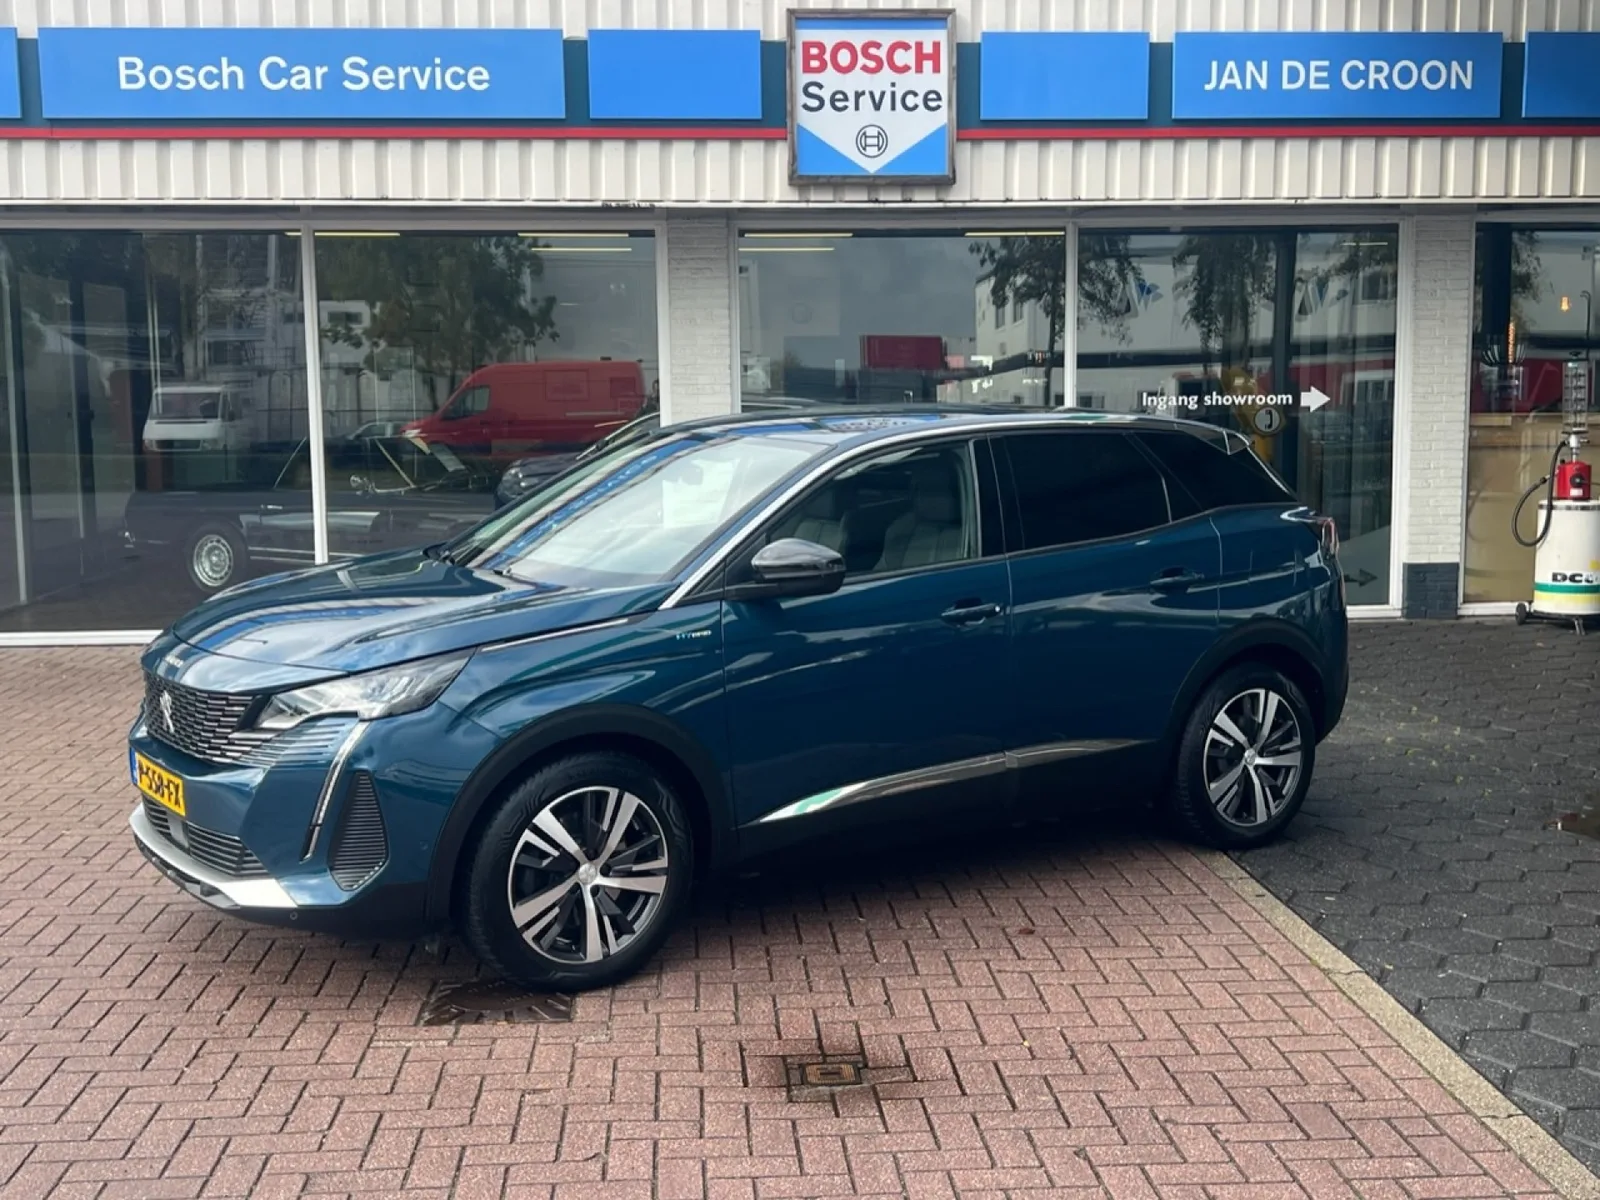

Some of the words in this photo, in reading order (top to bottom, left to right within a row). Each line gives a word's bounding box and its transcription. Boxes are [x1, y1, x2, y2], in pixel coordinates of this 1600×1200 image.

[118, 56, 245, 91] Bosch
[259, 55, 329, 91] Car
[342, 56, 490, 91] Service
[801, 40, 942, 75] BOSCH
[1204, 60, 1268, 91] JAN
[1281, 60, 1330, 90] DE
[1341, 59, 1474, 91] CROON
[801, 80, 943, 113] Service
[1142, 391, 1198, 411] Ingang
[1204, 391, 1293, 406] showroom
